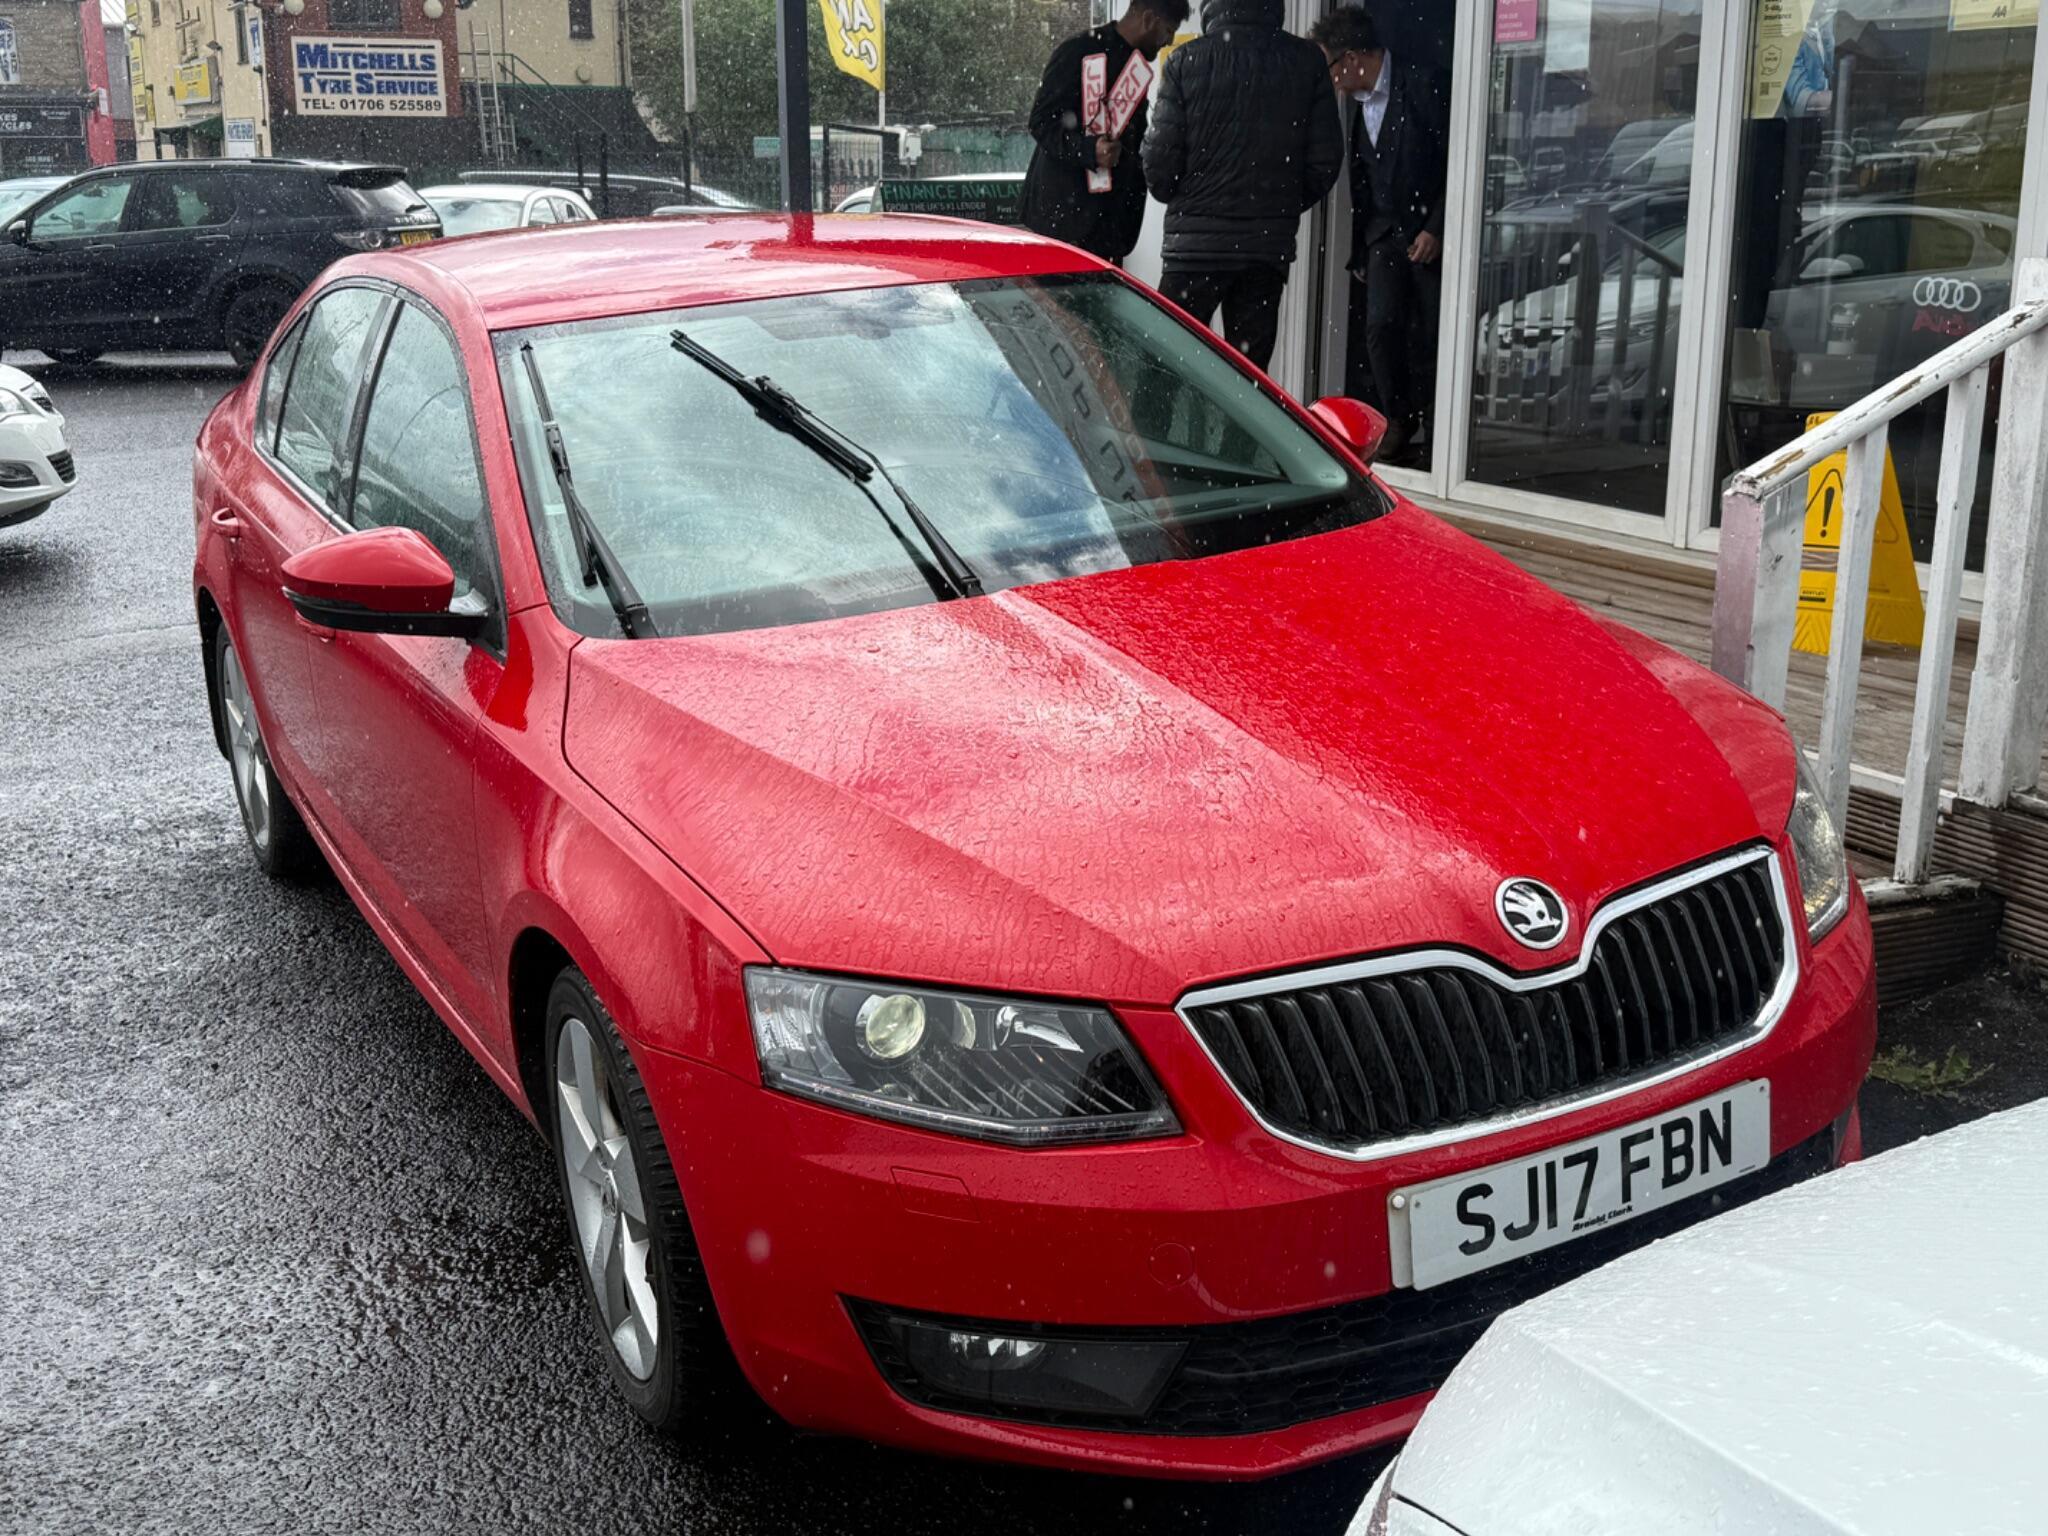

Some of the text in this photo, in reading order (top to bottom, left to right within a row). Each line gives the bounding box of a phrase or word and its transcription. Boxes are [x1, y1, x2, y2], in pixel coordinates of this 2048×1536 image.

[296, 43, 436, 71] MITCHELLS
[299, 72, 439, 95] TYRE SERVICE
[302, 98, 442, 111] TEL: 01706 525589
[884, 184, 957, 200] FINANCE
[1456, 1100, 1732, 1256] SJ17 FBN
[1572, 1205, 1633, 1232] Arnold Clark
